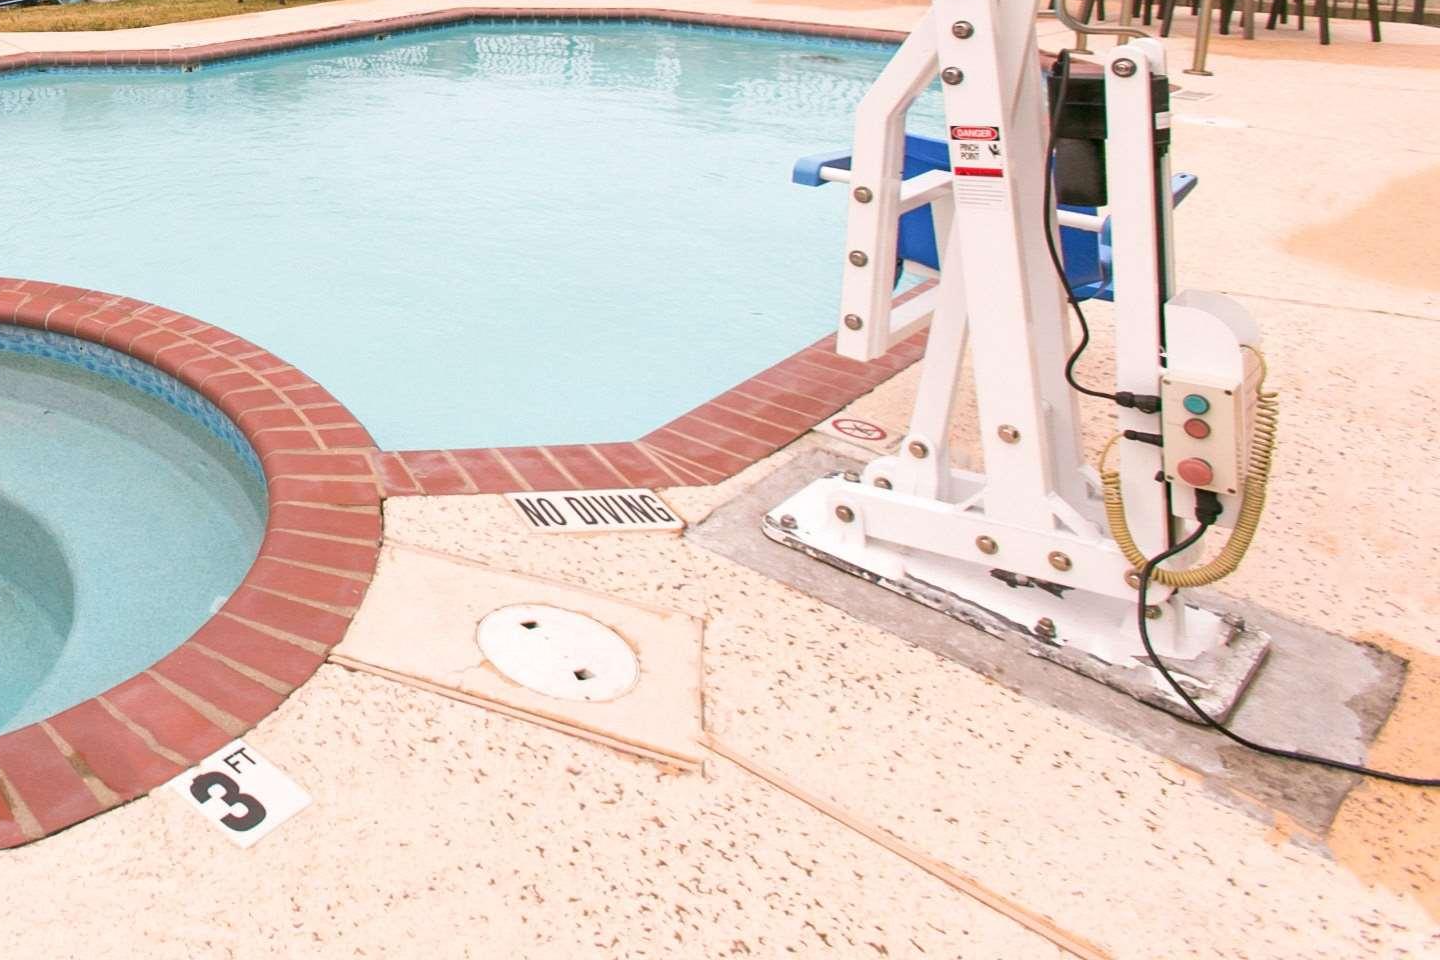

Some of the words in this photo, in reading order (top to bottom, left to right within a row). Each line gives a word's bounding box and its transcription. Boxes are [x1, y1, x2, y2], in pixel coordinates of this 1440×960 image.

[956, 129, 992, 138] DANGER
[514, 497, 567, 528] NO
[563, 494, 676, 526] DIVING
[223, 747, 257, 774] FT
[189, 771, 267, 832] 3
